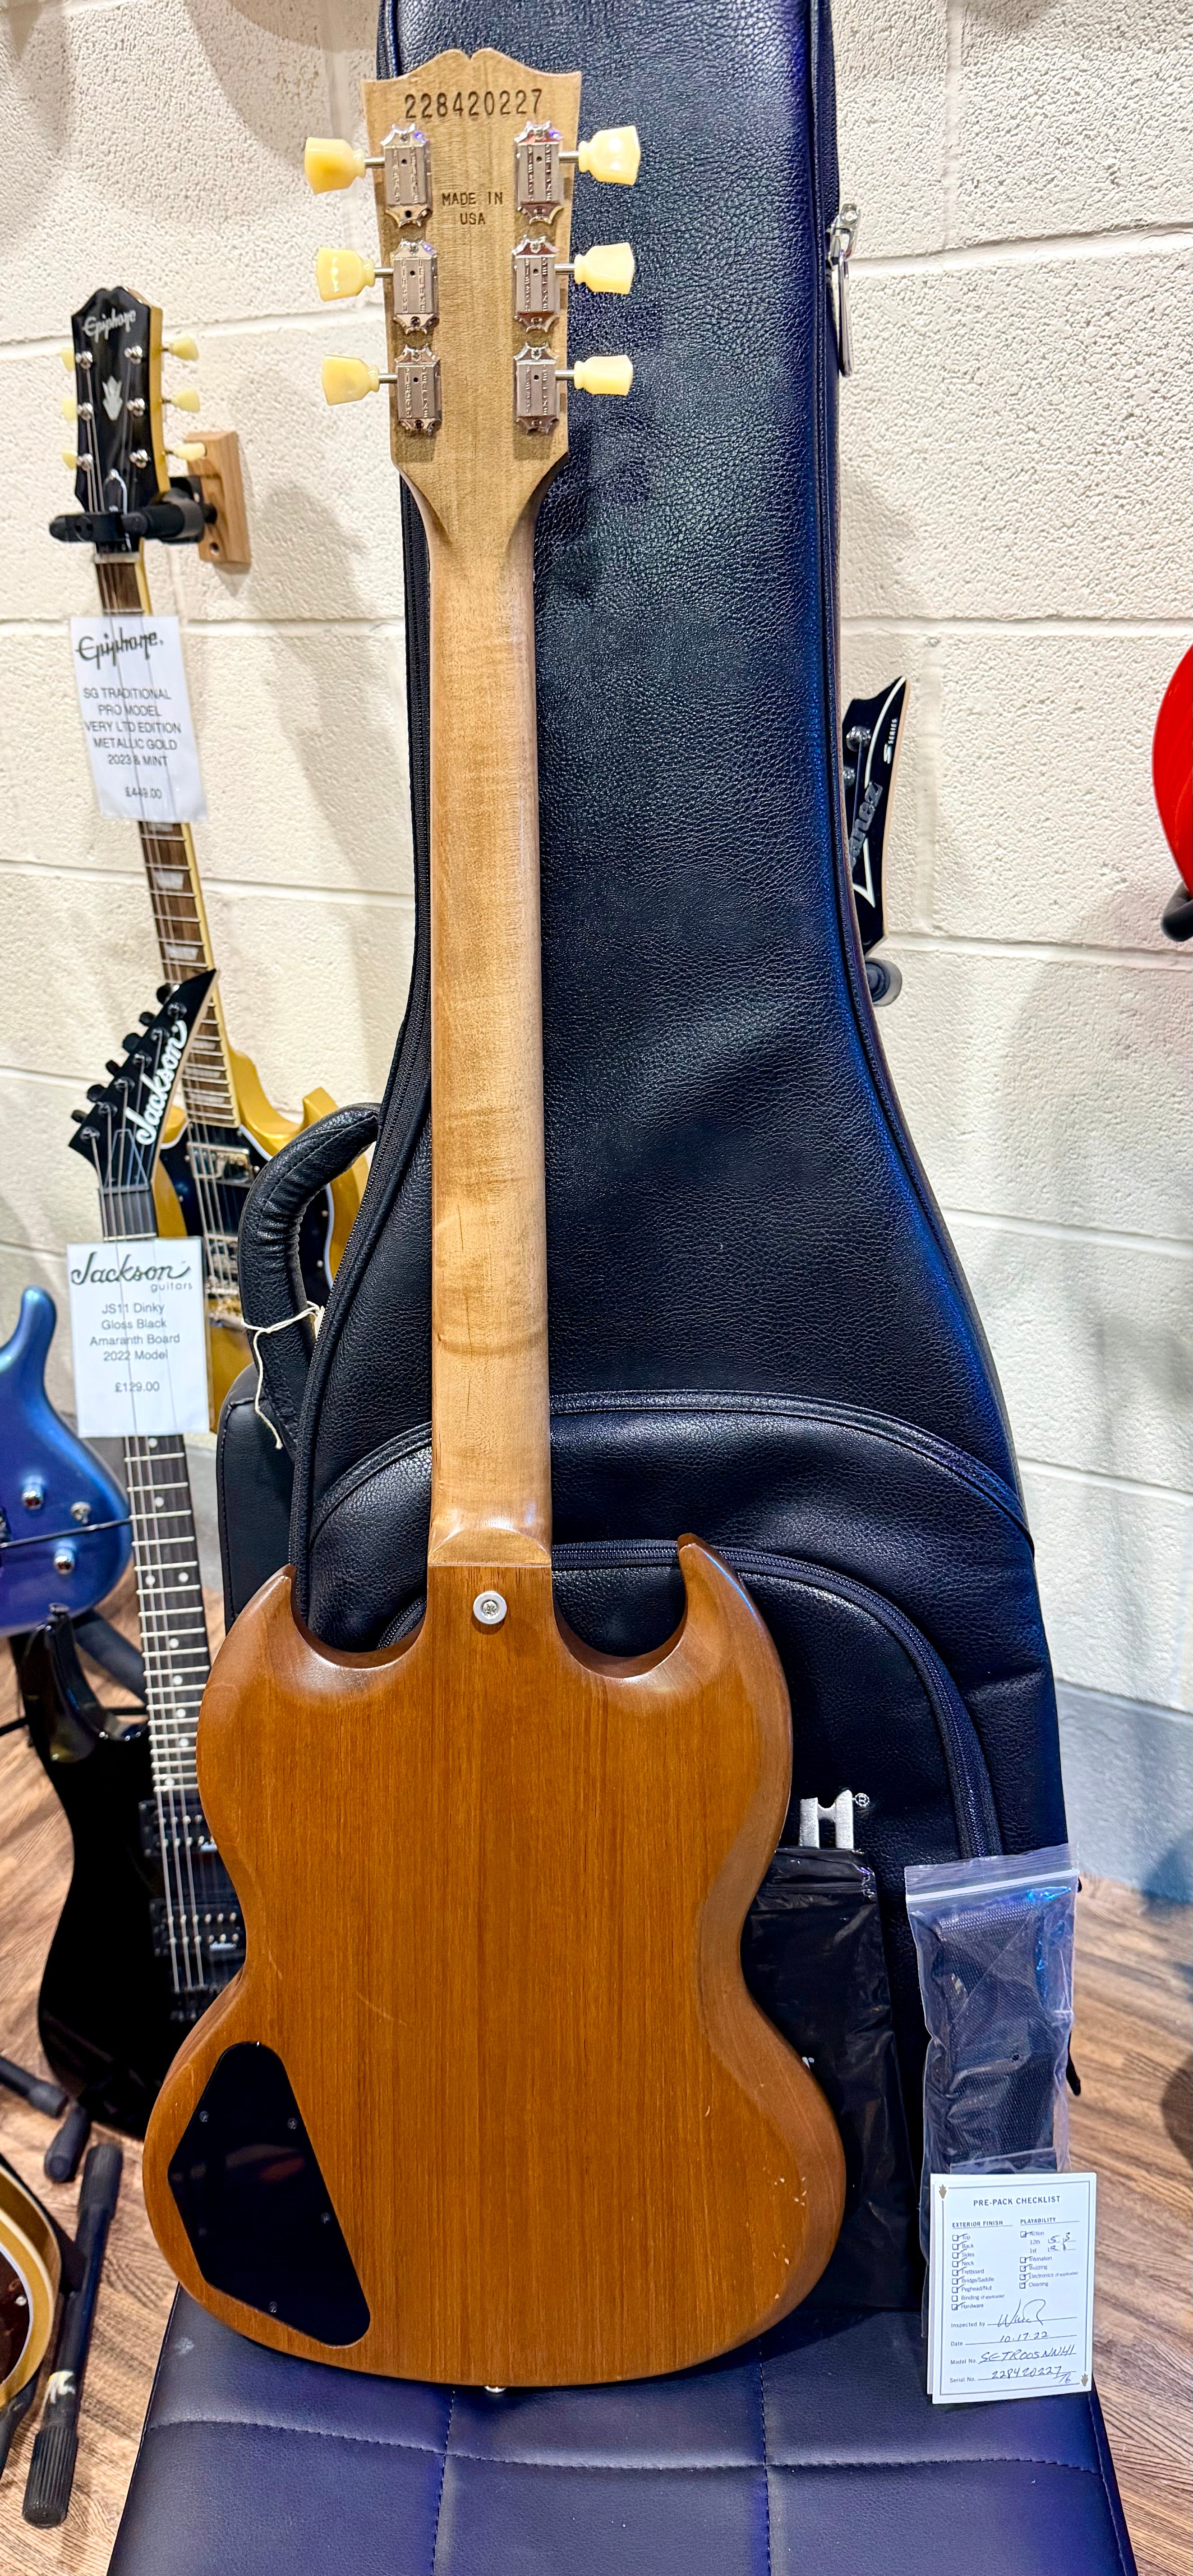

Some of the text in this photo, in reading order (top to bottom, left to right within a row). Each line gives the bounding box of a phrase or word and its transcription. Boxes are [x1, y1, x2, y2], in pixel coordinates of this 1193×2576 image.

[405, 89, 542, 119] 228420227
[442, 192, 503, 206] MADE IN
[460, 212, 486, 225] USA
[83, 688, 171, 699] SG TRADITIONAL
[99, 704, 161, 717] PRO MODEL
[84, 722, 181, 733] VERY LTD EDITION
[94, 738, 177, 750] METALLIC GOLD
[108, 754, 168, 766] 2023 & MINT
[125, 1020, 187, 1145] Jackson
[71, 1251, 190, 1285] Jackson
[151, 1282, 193, 1293] guitars
[102, 1303, 165, 1315] JS11 Dinky
[101, 1318, 166, 1330] Gloss Black
[90, 1334, 180, 1346] Amaranth Board
[104, 1349, 168, 1362] 2022 Model
[115, 1381, 160, 1392] £129.00
[973, 2196, 1060, 2206] PRE-PACK CHECKLIST
[992, 2366, 1062, 2379] 228420227
